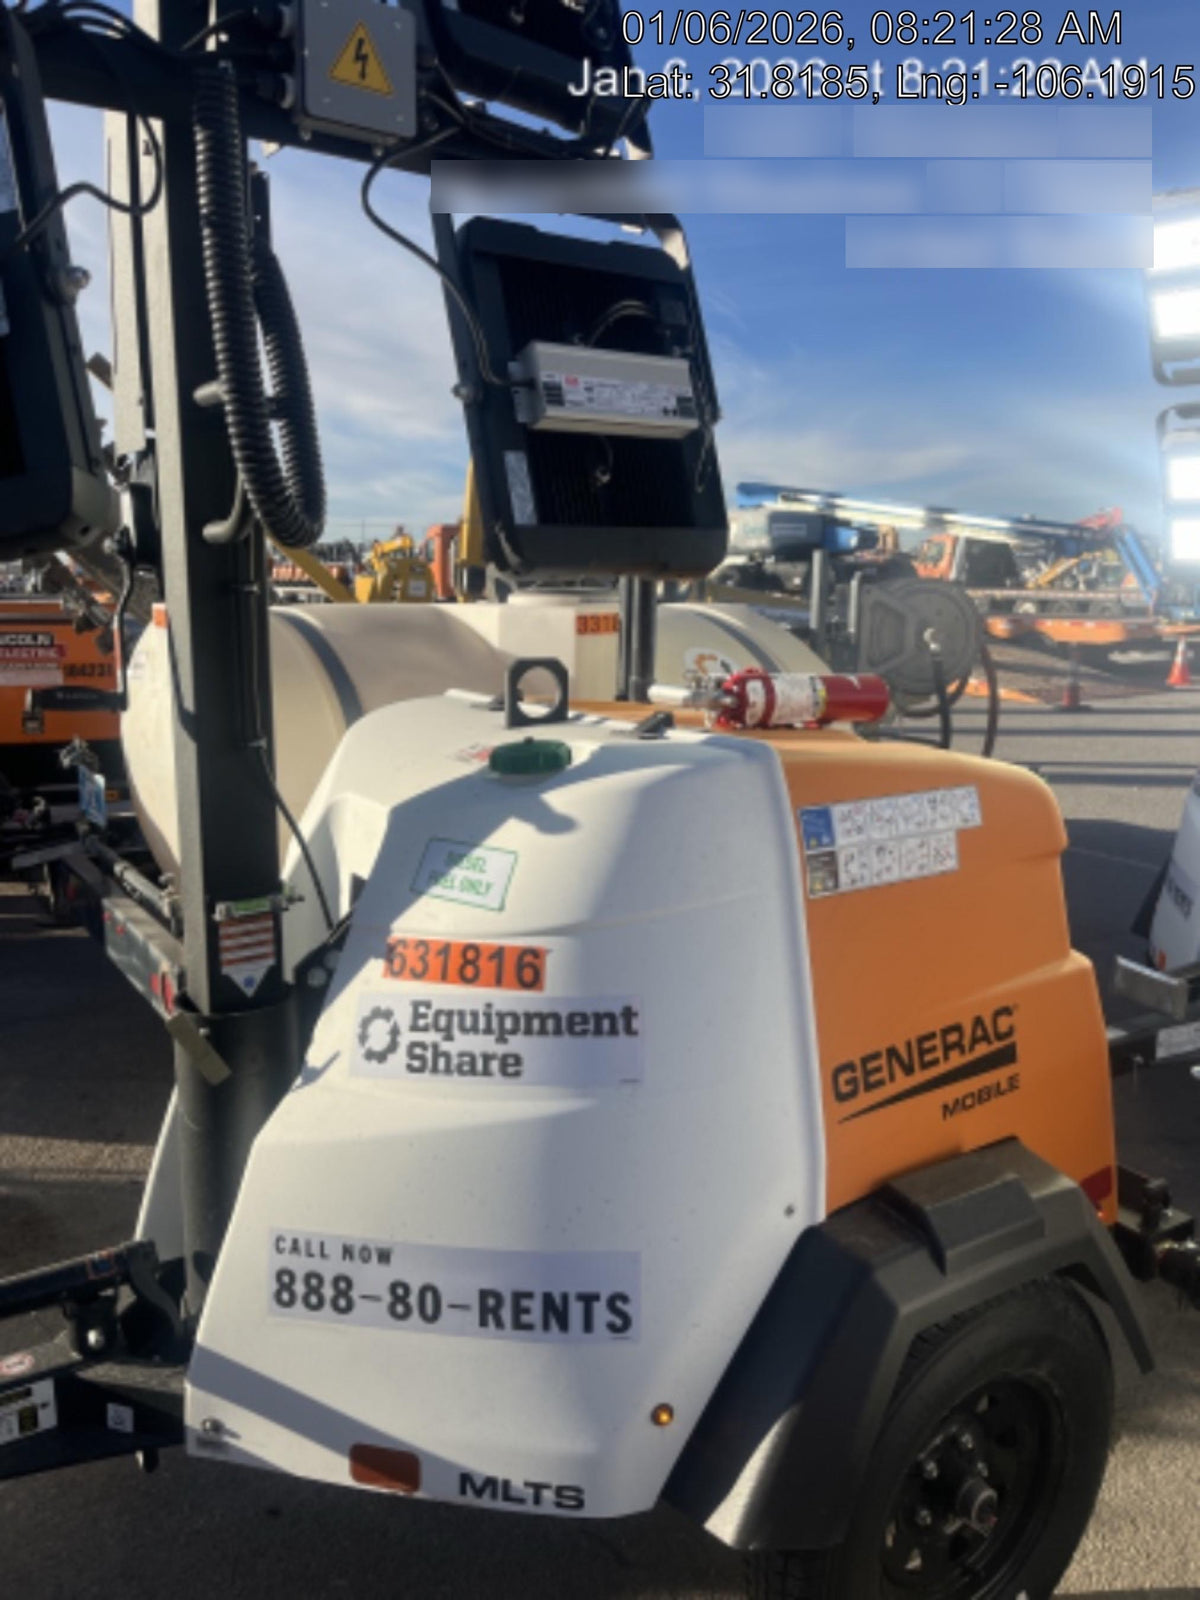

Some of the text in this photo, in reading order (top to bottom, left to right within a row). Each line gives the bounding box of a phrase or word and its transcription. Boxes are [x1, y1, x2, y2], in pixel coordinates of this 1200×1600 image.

[386, 937, 542, 989] 631816
[408, 1000, 640, 1044] Equipment
[405, 1041, 524, 1078] Share
[832, 1005, 1015, 1104] GENERAC
[941, 1073, 1020, 1121] MOBILE
[274, 1235, 394, 1266] CALL NOW
[273, 1267, 633, 1335] 888-80-RENTS
[458, 1471, 586, 1512] MLTS
